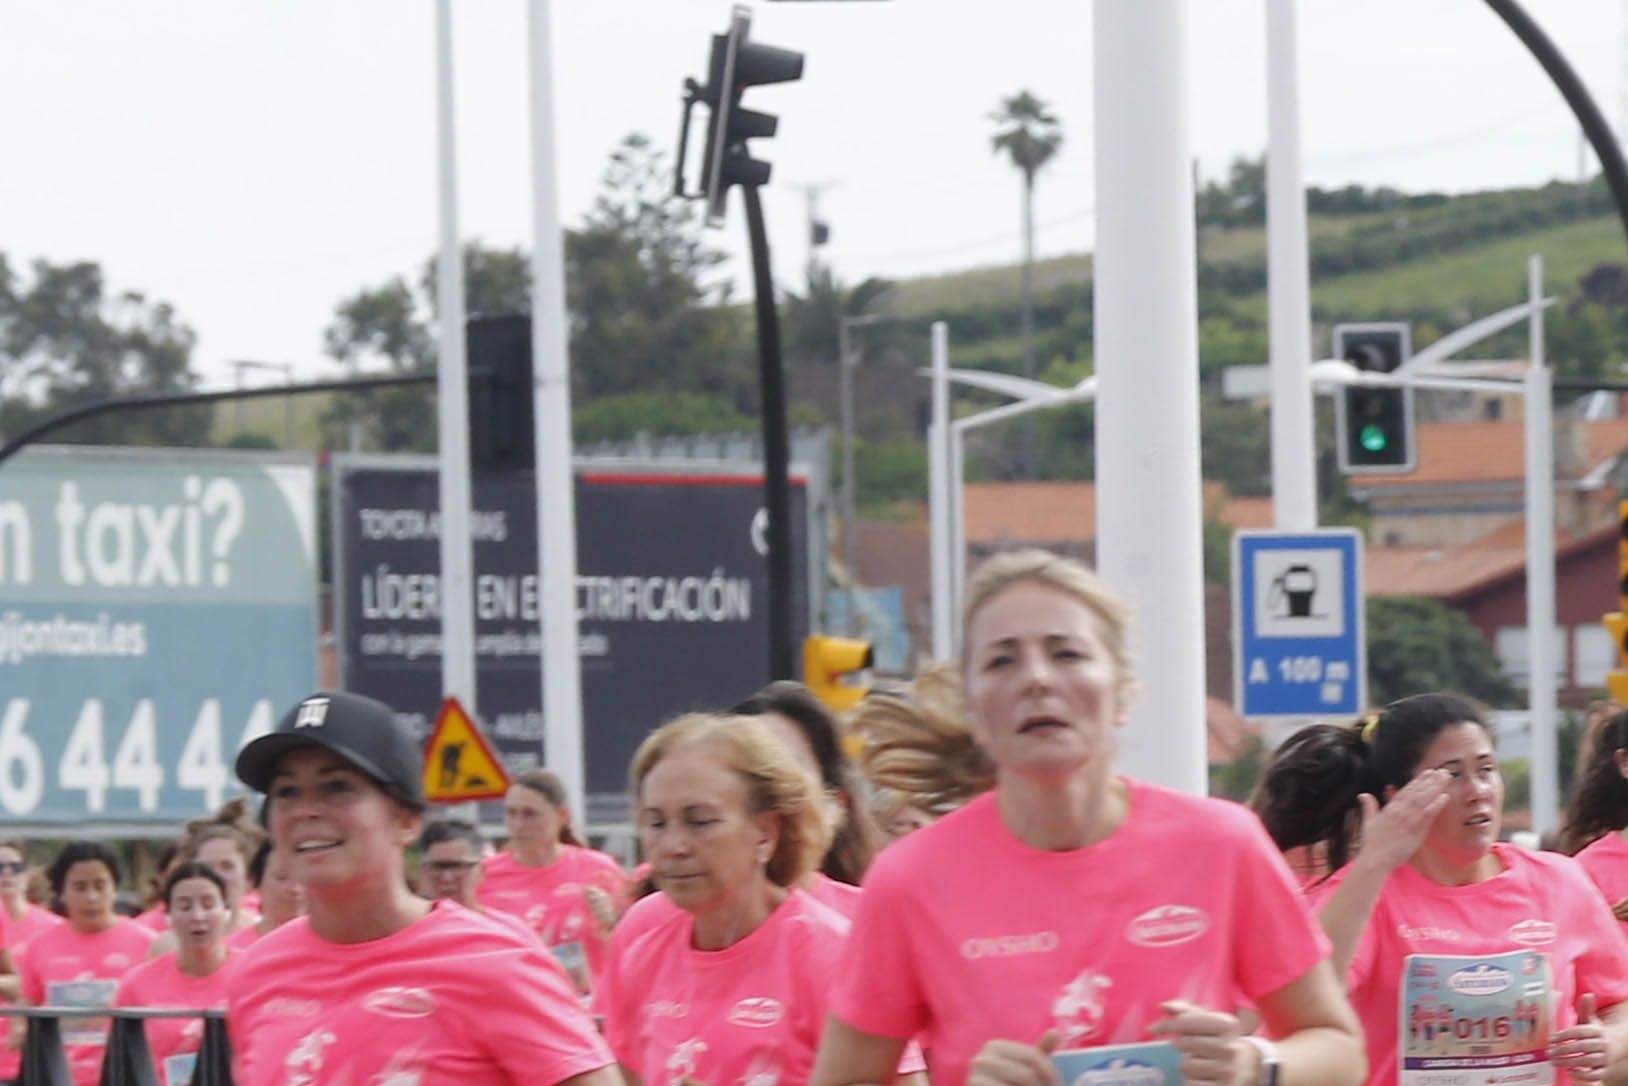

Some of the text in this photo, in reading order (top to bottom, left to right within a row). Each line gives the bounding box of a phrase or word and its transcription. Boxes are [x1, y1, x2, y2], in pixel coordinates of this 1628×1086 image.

[56, 474, 245, 588] taxi?
[476, 573, 517, 620] EN
[520, 565, 751, 622] ECTRIFICACIÓN
[1249, 656, 1270, 685] A
[1279, 656, 1322, 684] 100
[58, 698, 165, 813] 44
[1453, 1016, 1511, 1040] 016
